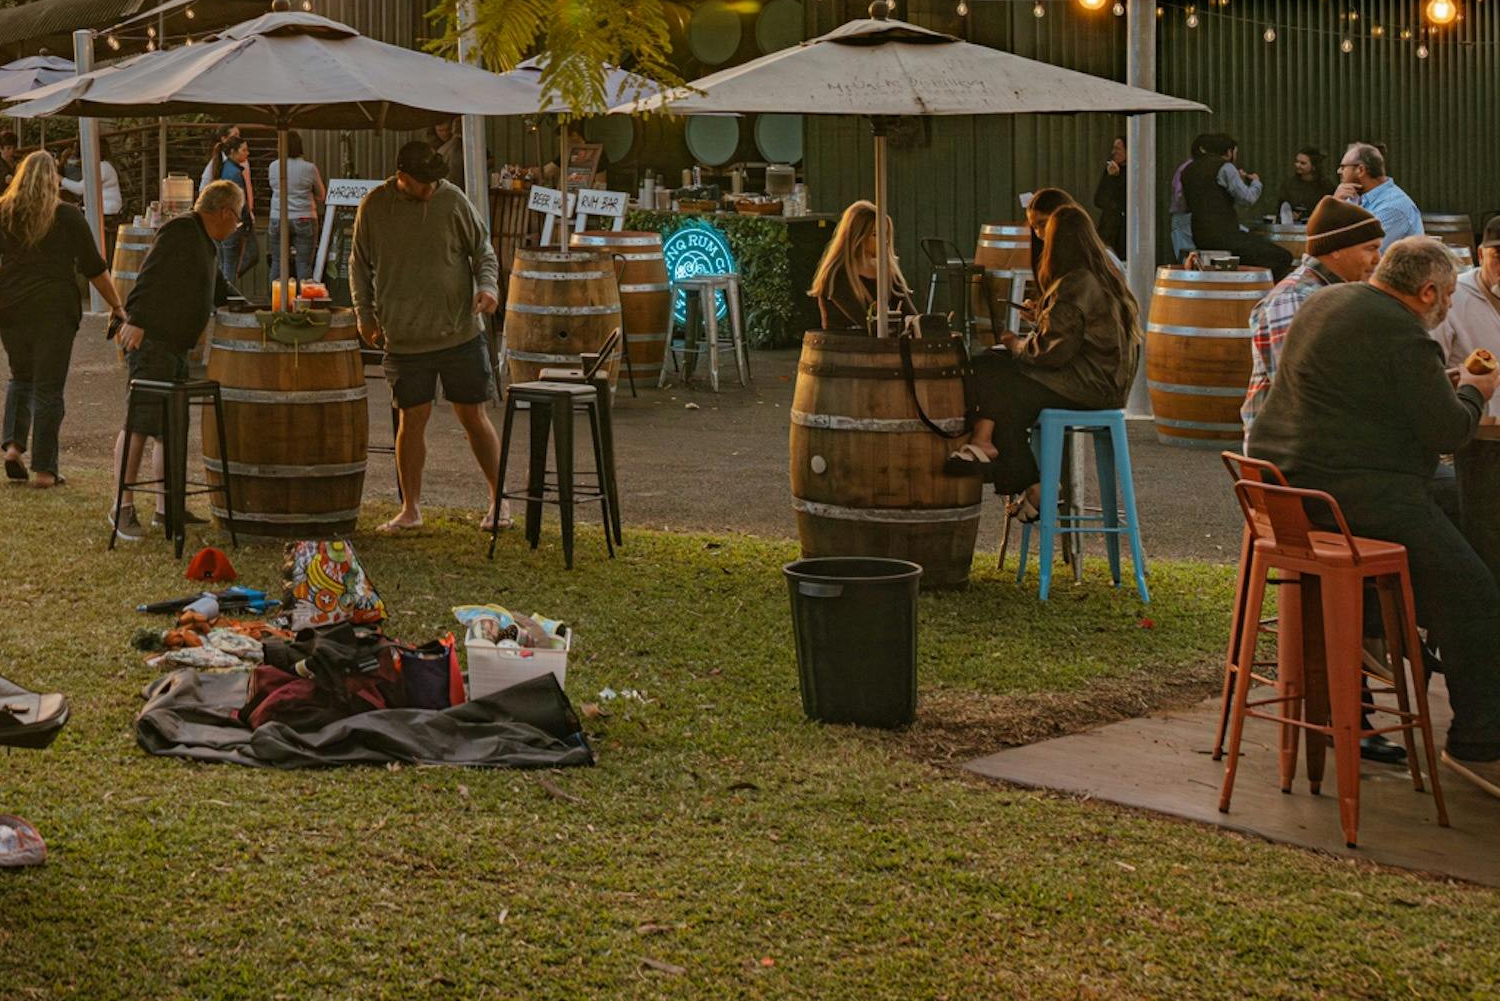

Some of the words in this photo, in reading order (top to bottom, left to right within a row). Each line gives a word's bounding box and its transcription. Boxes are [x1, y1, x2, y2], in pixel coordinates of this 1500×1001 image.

[532, 191, 551, 208] BEER
[581, 195, 599, 209] RUM
[601, 196, 619, 212] BAR
[688, 234, 718, 257] RUM
